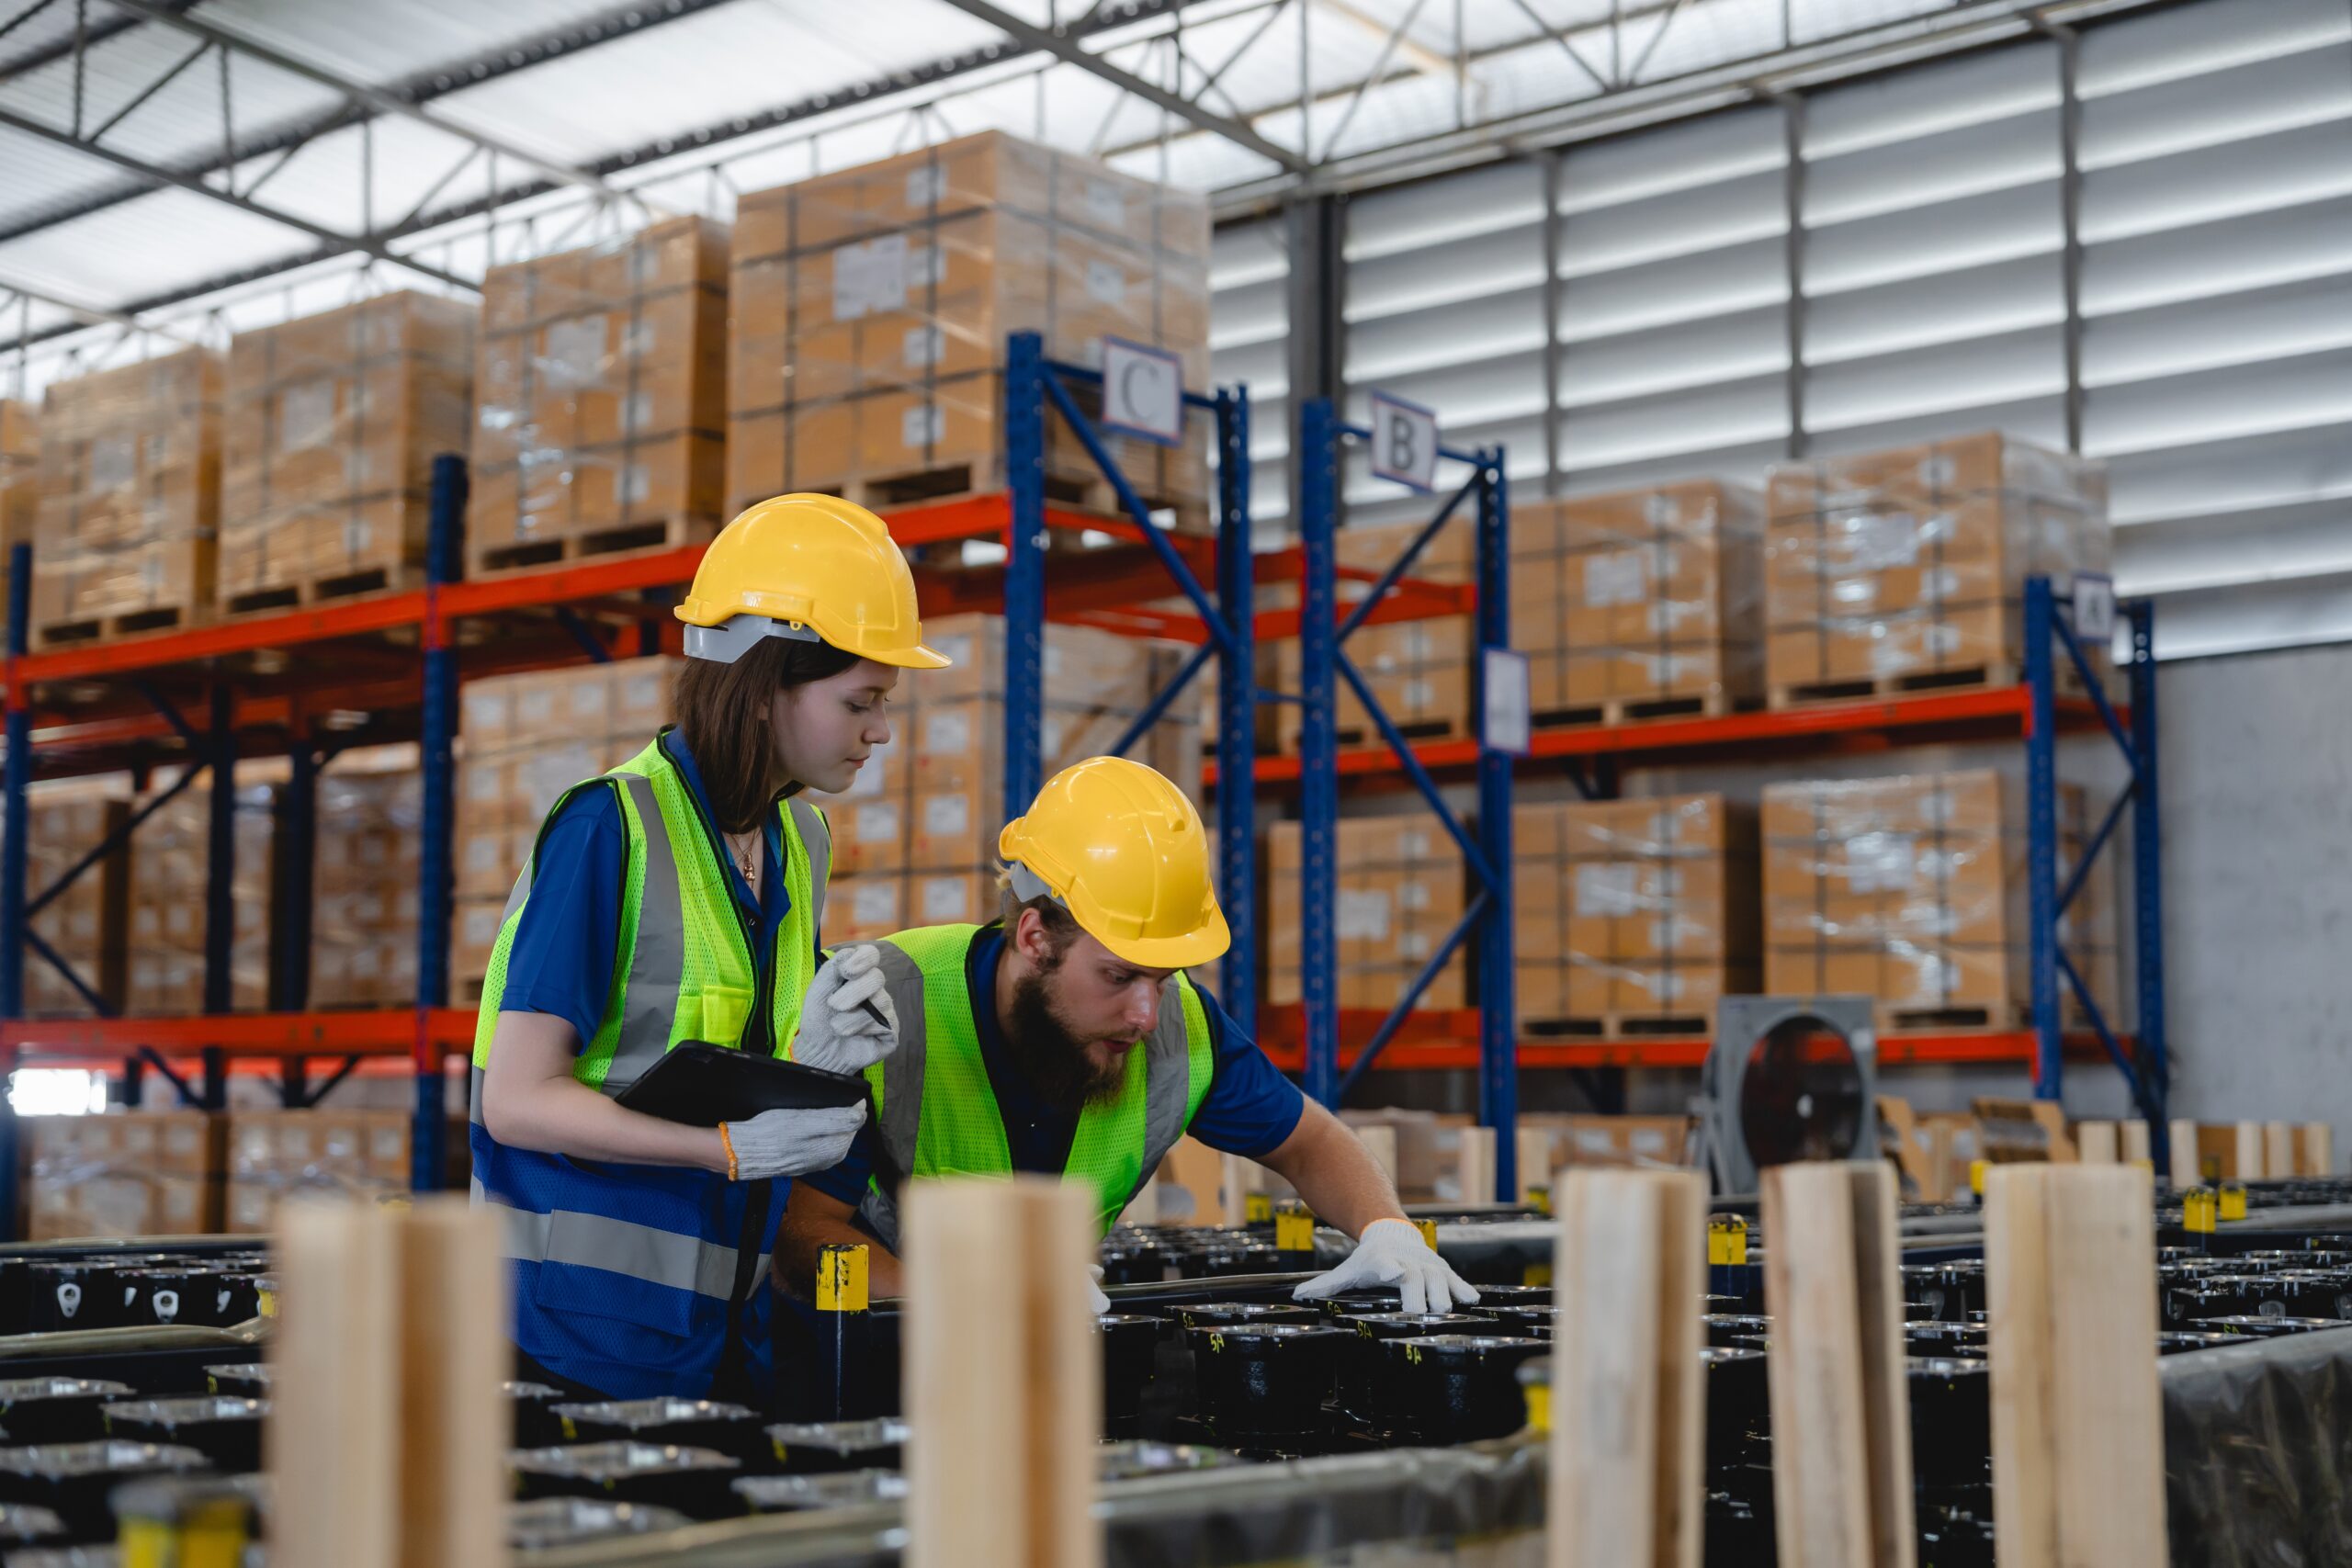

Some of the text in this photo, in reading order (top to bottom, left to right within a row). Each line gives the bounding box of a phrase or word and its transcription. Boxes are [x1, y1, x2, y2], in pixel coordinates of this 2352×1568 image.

[1121, 357, 1160, 424] C
[1390, 413, 1416, 471] B
[1209, 1333, 1225, 1353] 5A
